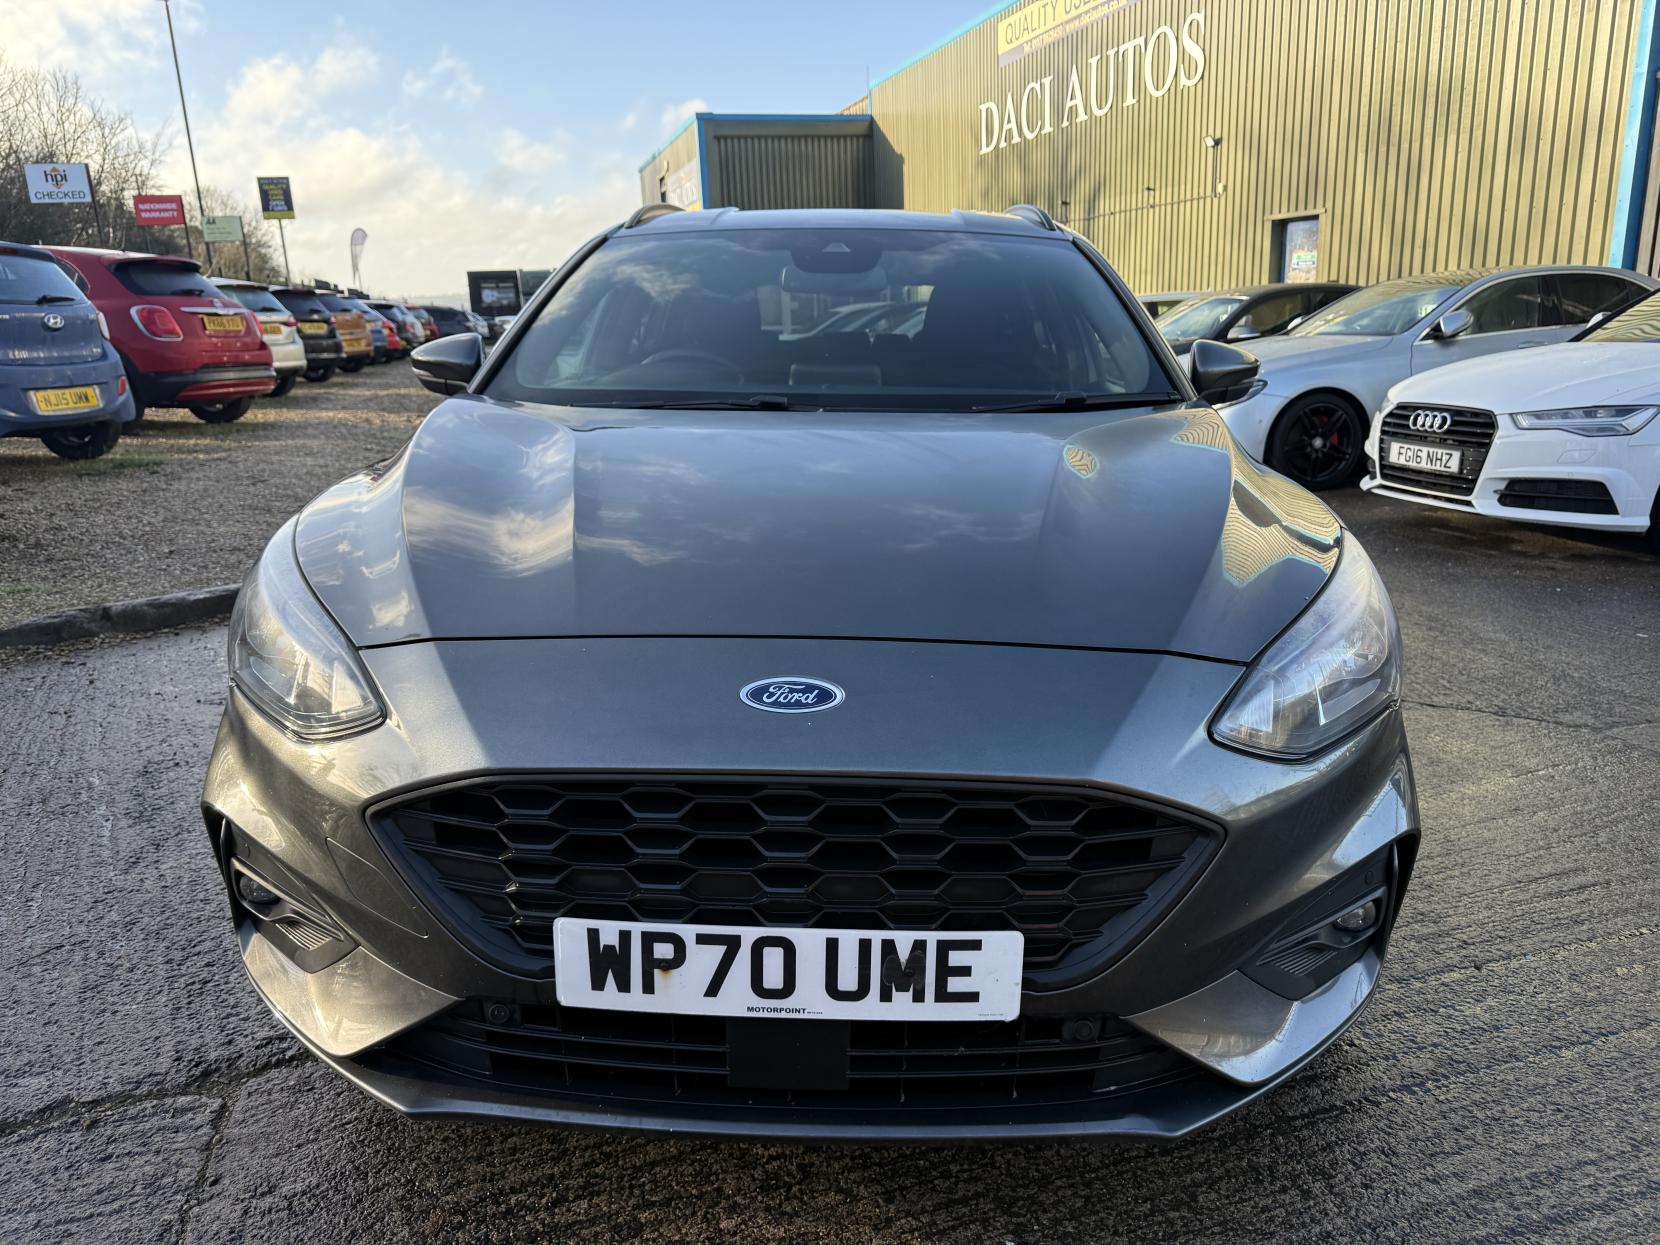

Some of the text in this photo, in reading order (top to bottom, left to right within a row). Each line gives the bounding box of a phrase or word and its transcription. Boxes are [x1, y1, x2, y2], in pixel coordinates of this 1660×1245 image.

[1005, 1, 1058, 45] QUALITY
[979, 75, 1053, 155] DACI
[1061, 9, 1205, 128] AUTOS
[43, 169, 68, 186] hpi
[34, 191, 86, 200] CHECKED
[43, 392, 69, 408] NJ15
[1397, 446, 1453, 469] FG16 NHZ
[762, 683, 819, 704] Ford
[586, 927, 983, 1004] WP70 UME
[746, 1006, 807, 1014] MOTORPOINT
